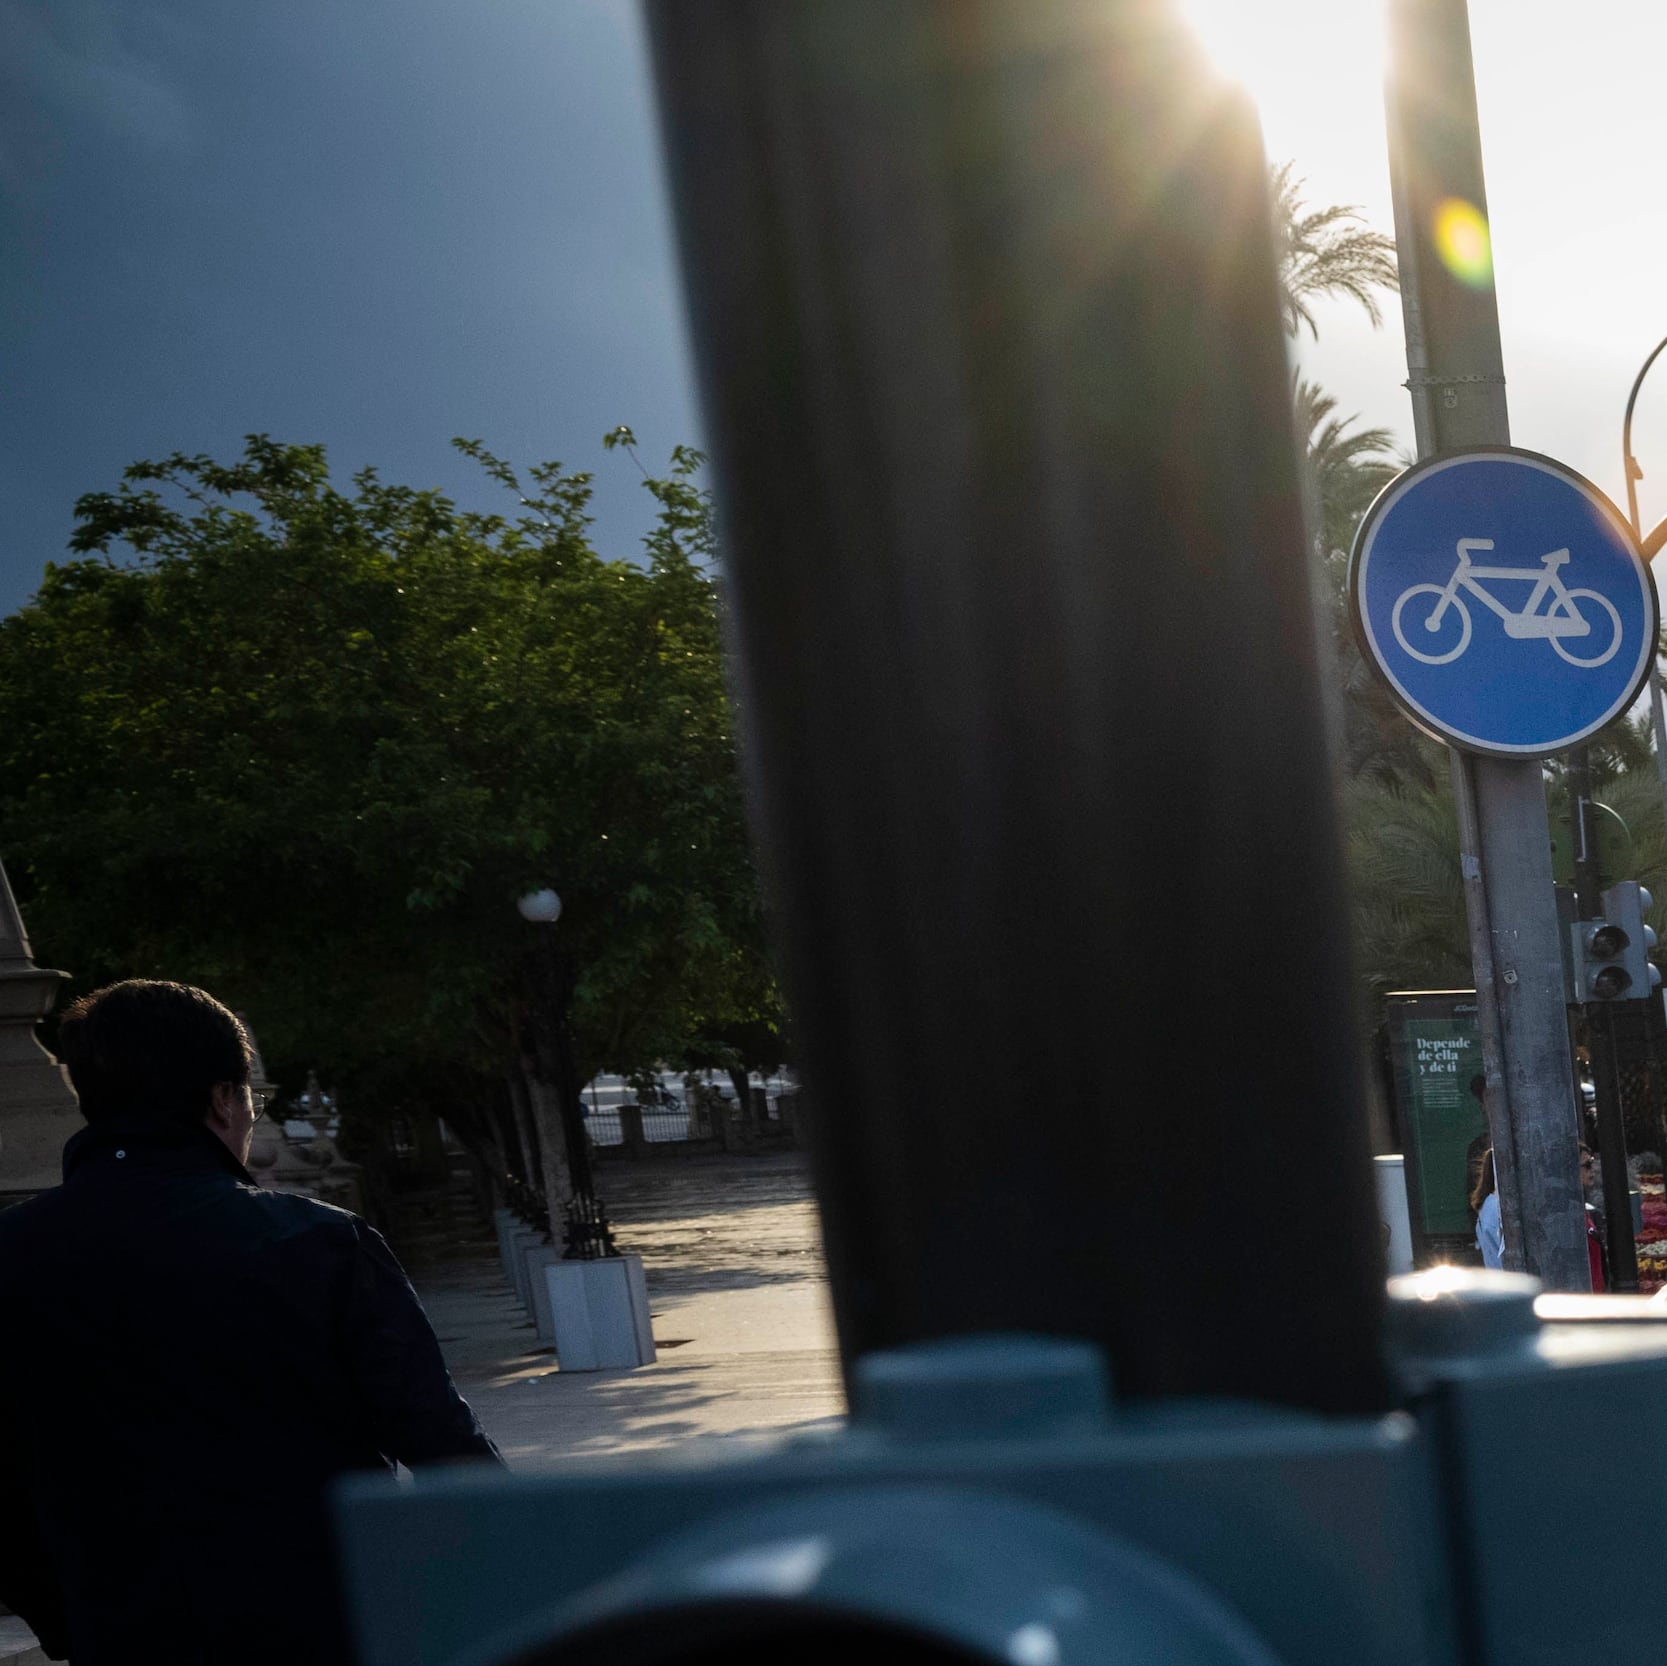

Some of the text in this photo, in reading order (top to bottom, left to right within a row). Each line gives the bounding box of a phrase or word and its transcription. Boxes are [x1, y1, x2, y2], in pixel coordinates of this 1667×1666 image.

[1417, 1037, 1471, 1053] Depende
[1418, 1050, 1459, 1062] de ella
[1420, 1061, 1457, 1075] y de ti
